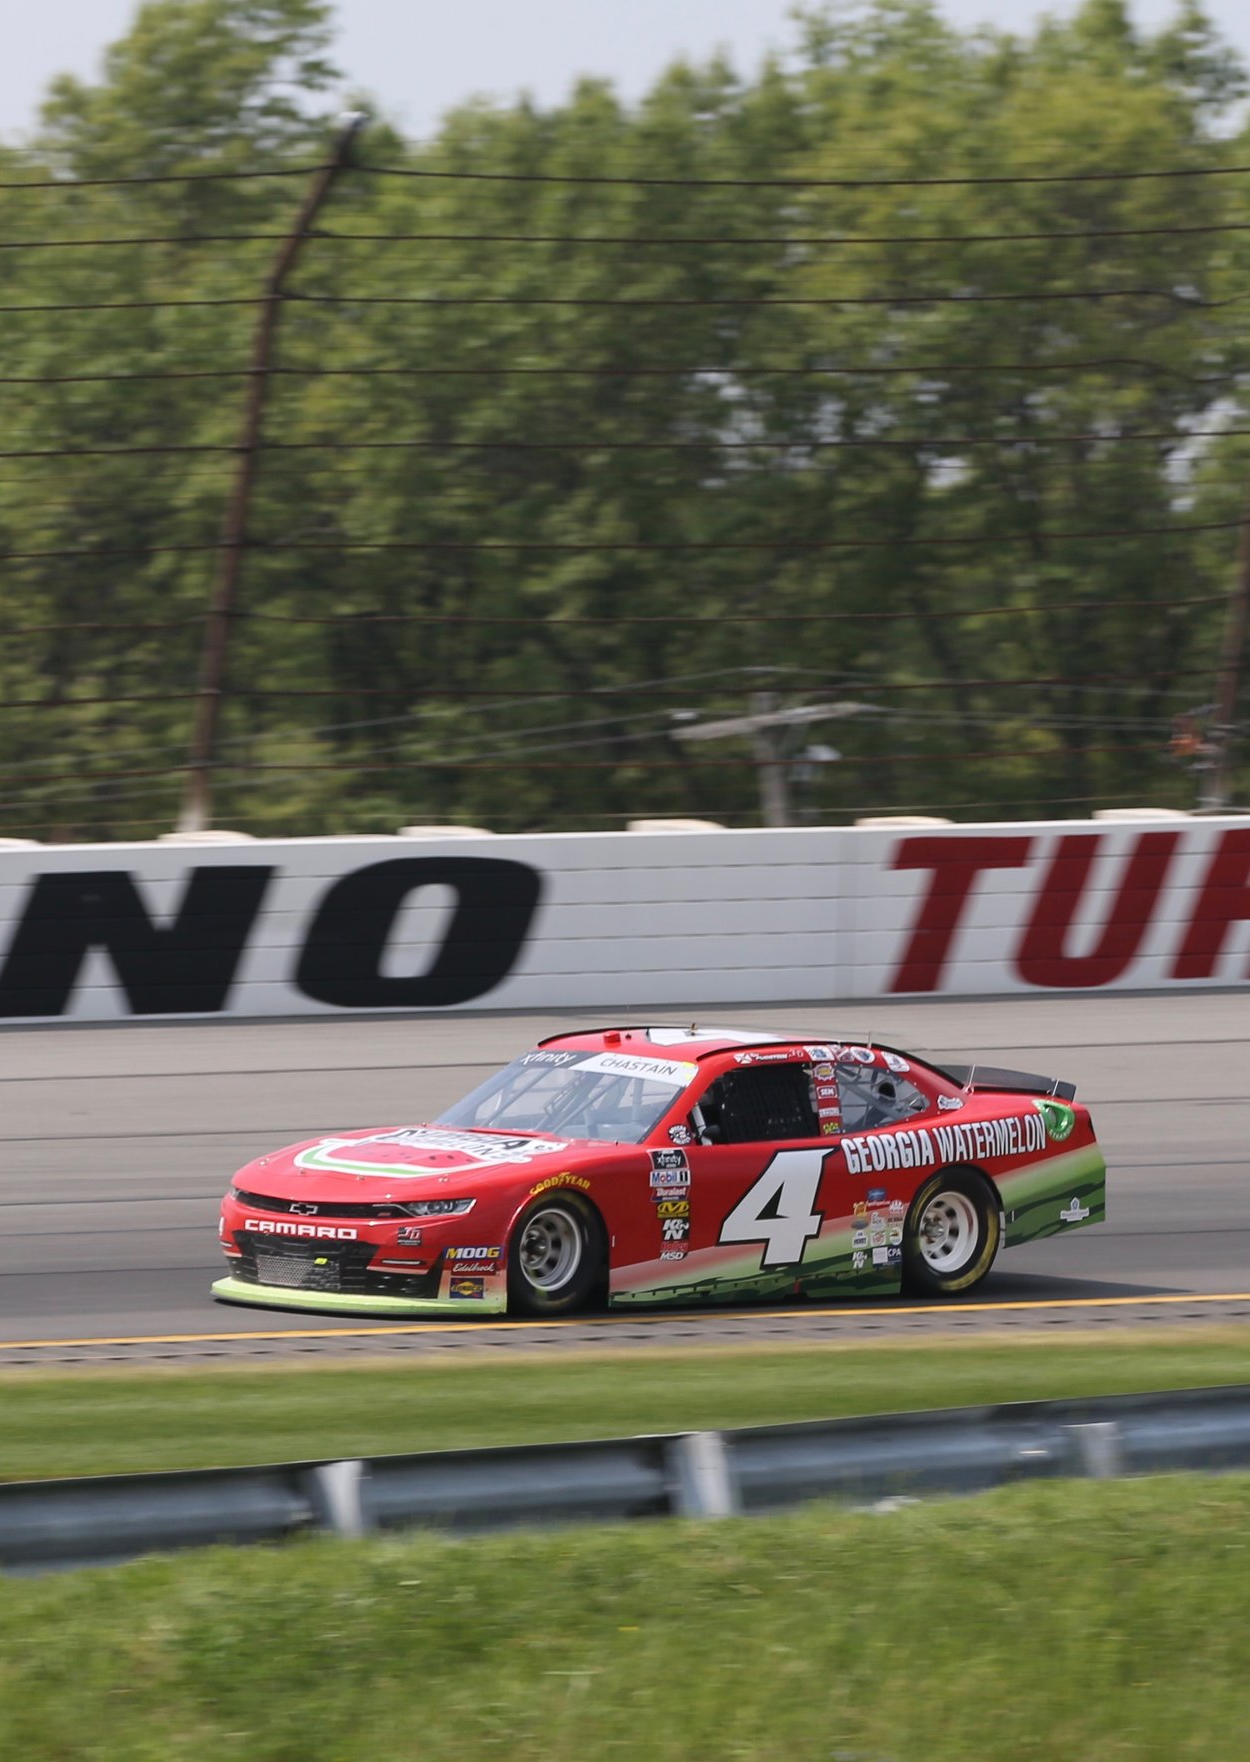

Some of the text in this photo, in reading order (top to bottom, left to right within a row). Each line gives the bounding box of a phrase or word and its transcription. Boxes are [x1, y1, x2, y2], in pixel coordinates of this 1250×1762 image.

[521, 1051, 678, 1075] xfinity CHASTAIN
[841, 1113, 1046, 1174] GEORGIA WATERMELON
[529, 1171, 590, 1195] GOODYEAR
[717, 1146, 836, 1268] 4
[244, 1219, 358, 1240] CAMARO
[446, 1247, 500, 1259] MOOG
[660, 1252, 685, 1260] MSD
[453, 1262, 495, 1272] Edelbrock
